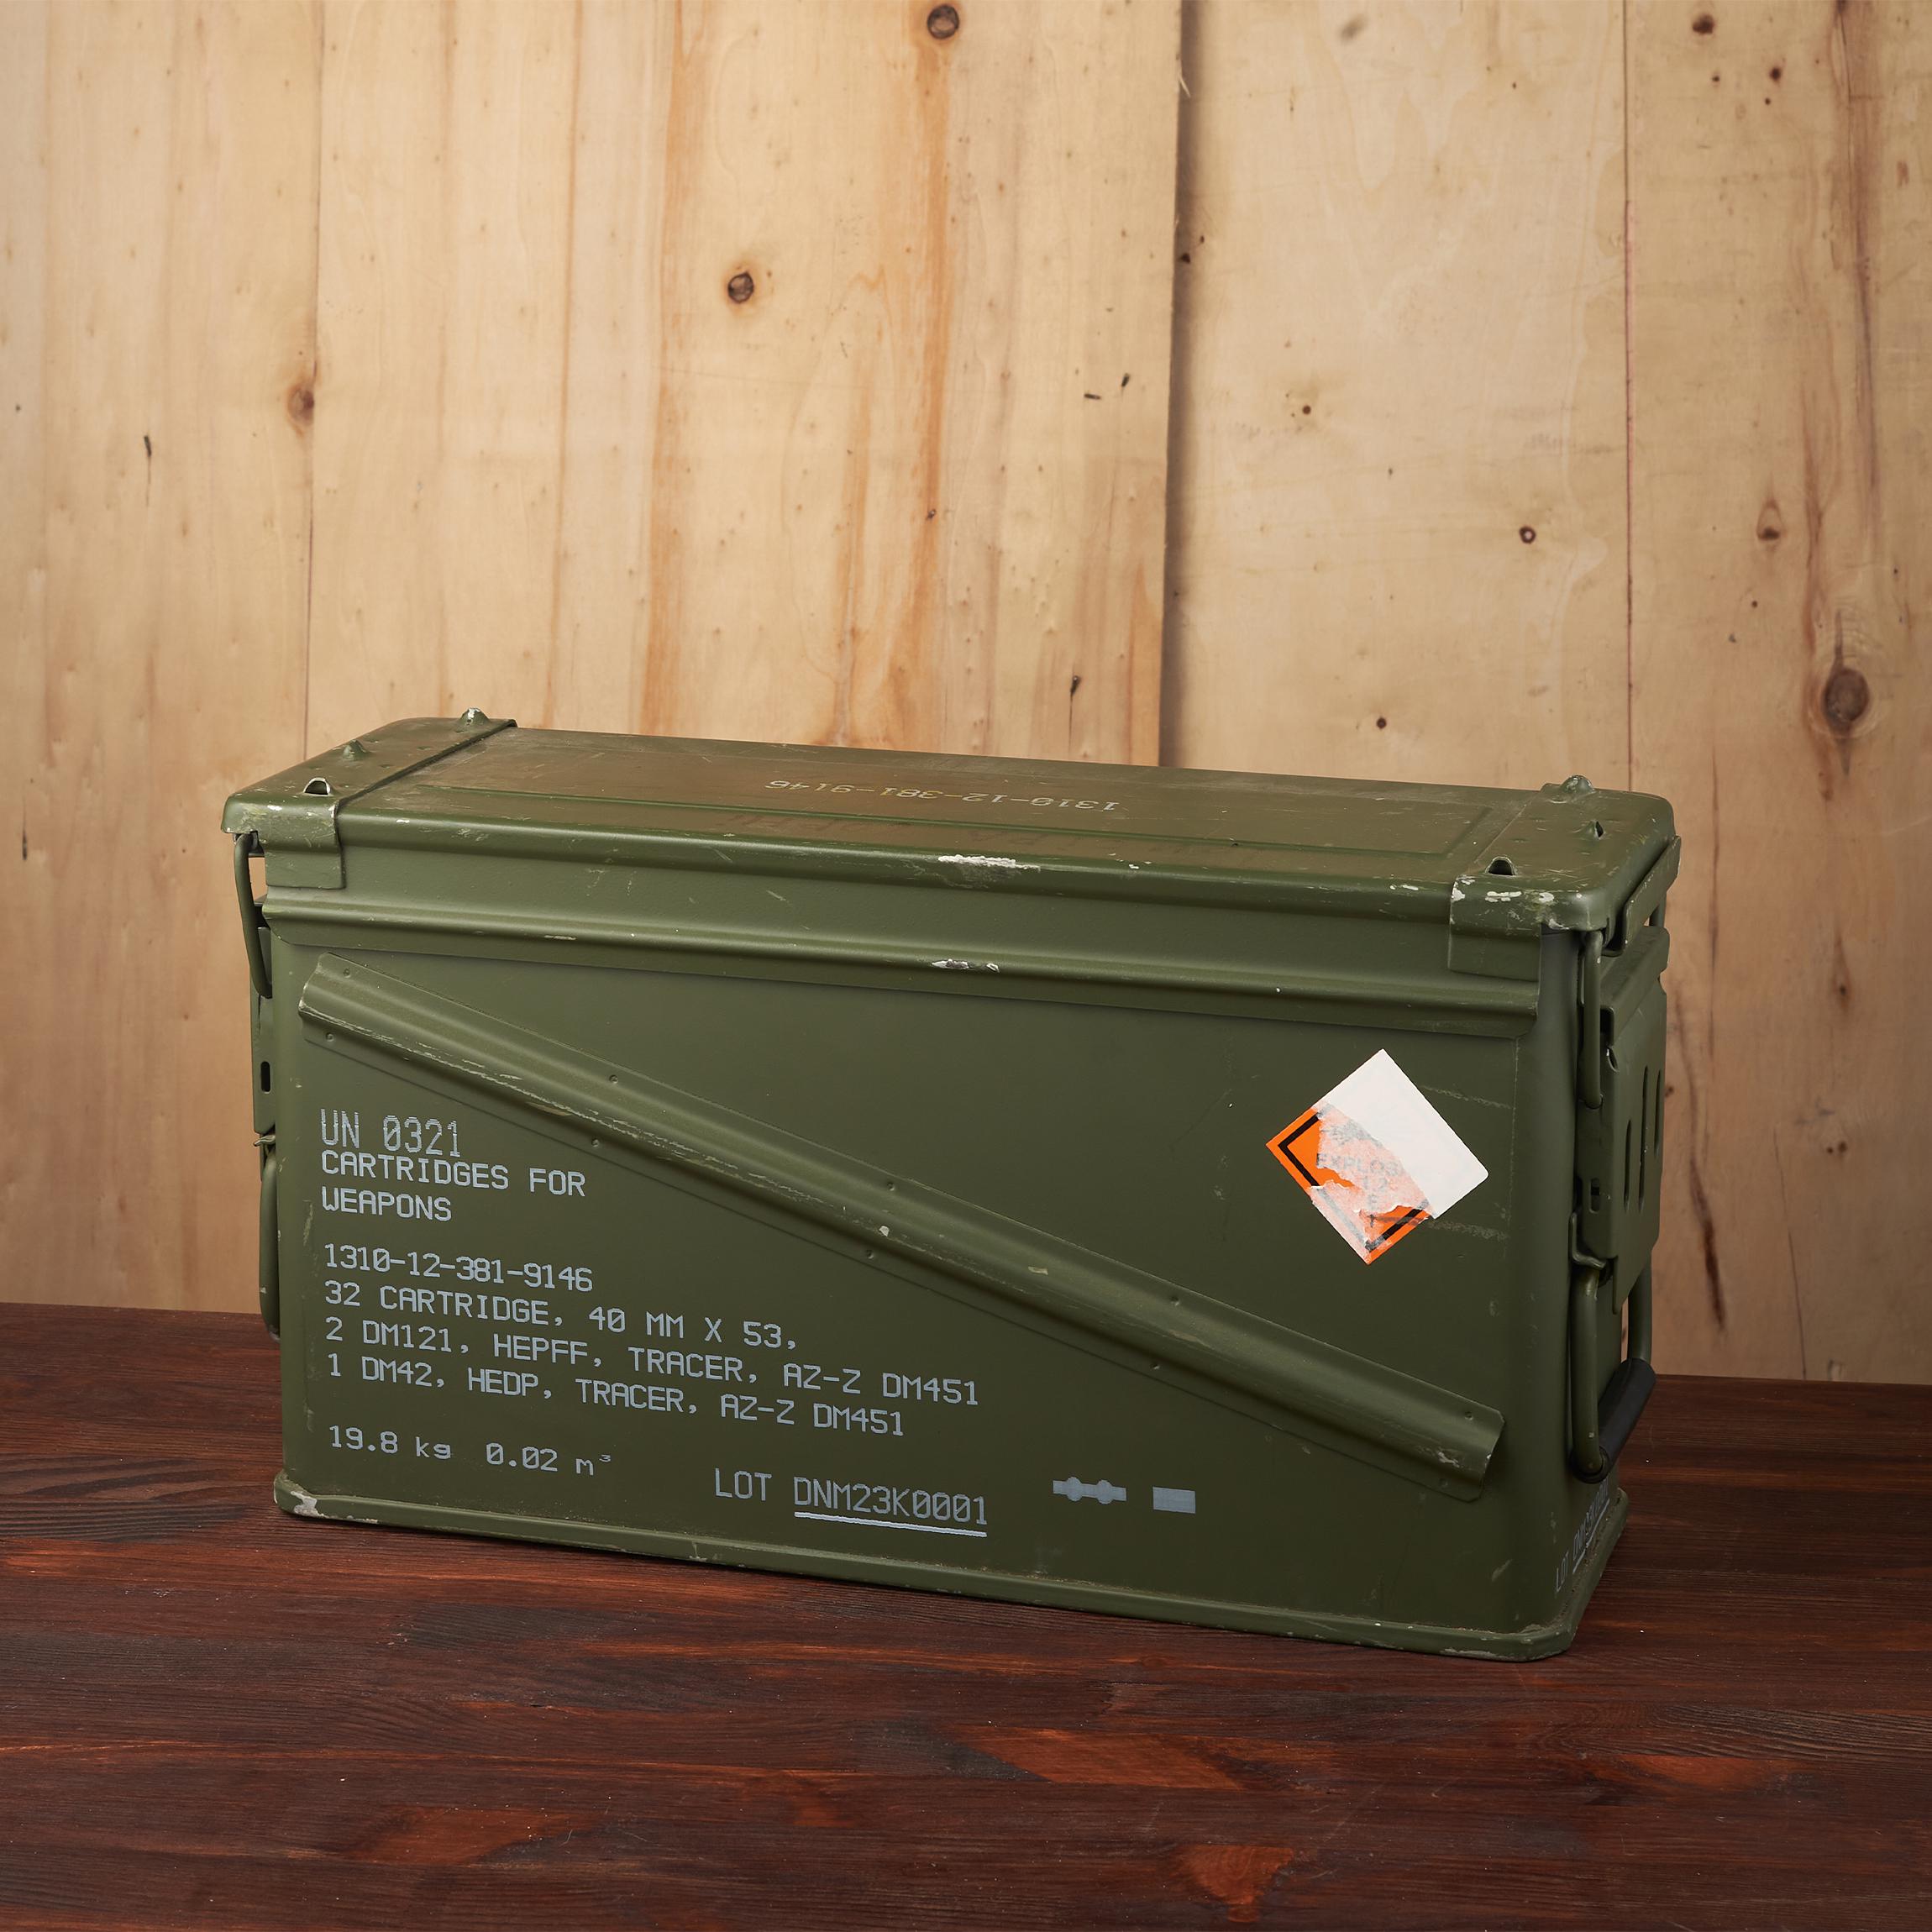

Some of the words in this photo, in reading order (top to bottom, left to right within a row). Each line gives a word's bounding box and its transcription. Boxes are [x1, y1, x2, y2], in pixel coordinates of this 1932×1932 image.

[764, 780, 1120, 811] 1310-12-381-9146
[319, 1108, 360, 1149] UN
[382, 1115, 461, 1158] 0321
[321, 1149, 509, 1190] CARTRIDGES
[529, 1167, 585, 1197] FOR
[1316, 1152, 1405, 1176] EXPLOS
[321, 1185, 452, 1222] WEAPONS
[324, 1242, 593, 1292] 1310-12-381-9146
[324, 1279, 361, 1307] 32
[380, 1285, 563, 1326] CARTRIDGE,
[588, 1306, 626, 1333] 40
[646, 1310, 684, 1339] MM
[704, 1316, 722, 1343] X
[743, 1320, 796, 1350] 53,
[325, 1316, 344, 1341] 2
[362, 1320, 469, 1354] DM121,
[493, 1333, 601, 1368] HEPFF,
[627, 1347, 757, 1383] TRACER,
[783, 1362, 861, 1394] AZ-Z
[882, 1372, 979, 1405] DM451
[328, 1352, 342, 1377] 1
[360, 1356, 444, 1388] DM42,
[467, 1367, 552, 1399] HEDP,
[575, 1378, 697, 1415] TRACER,
[720, 1393, 795, 1425] AZ-Z
[812, 1403, 904, 1436] DM451
[328, 1425, 398, 1454] 19.8
[415, 1436, 452, 1460] kg
[486, 1442, 559, 1472] 0.02
[715, 1467, 773, 1501] LOT
[793, 1476, 988, 1525] DNM23K0001
